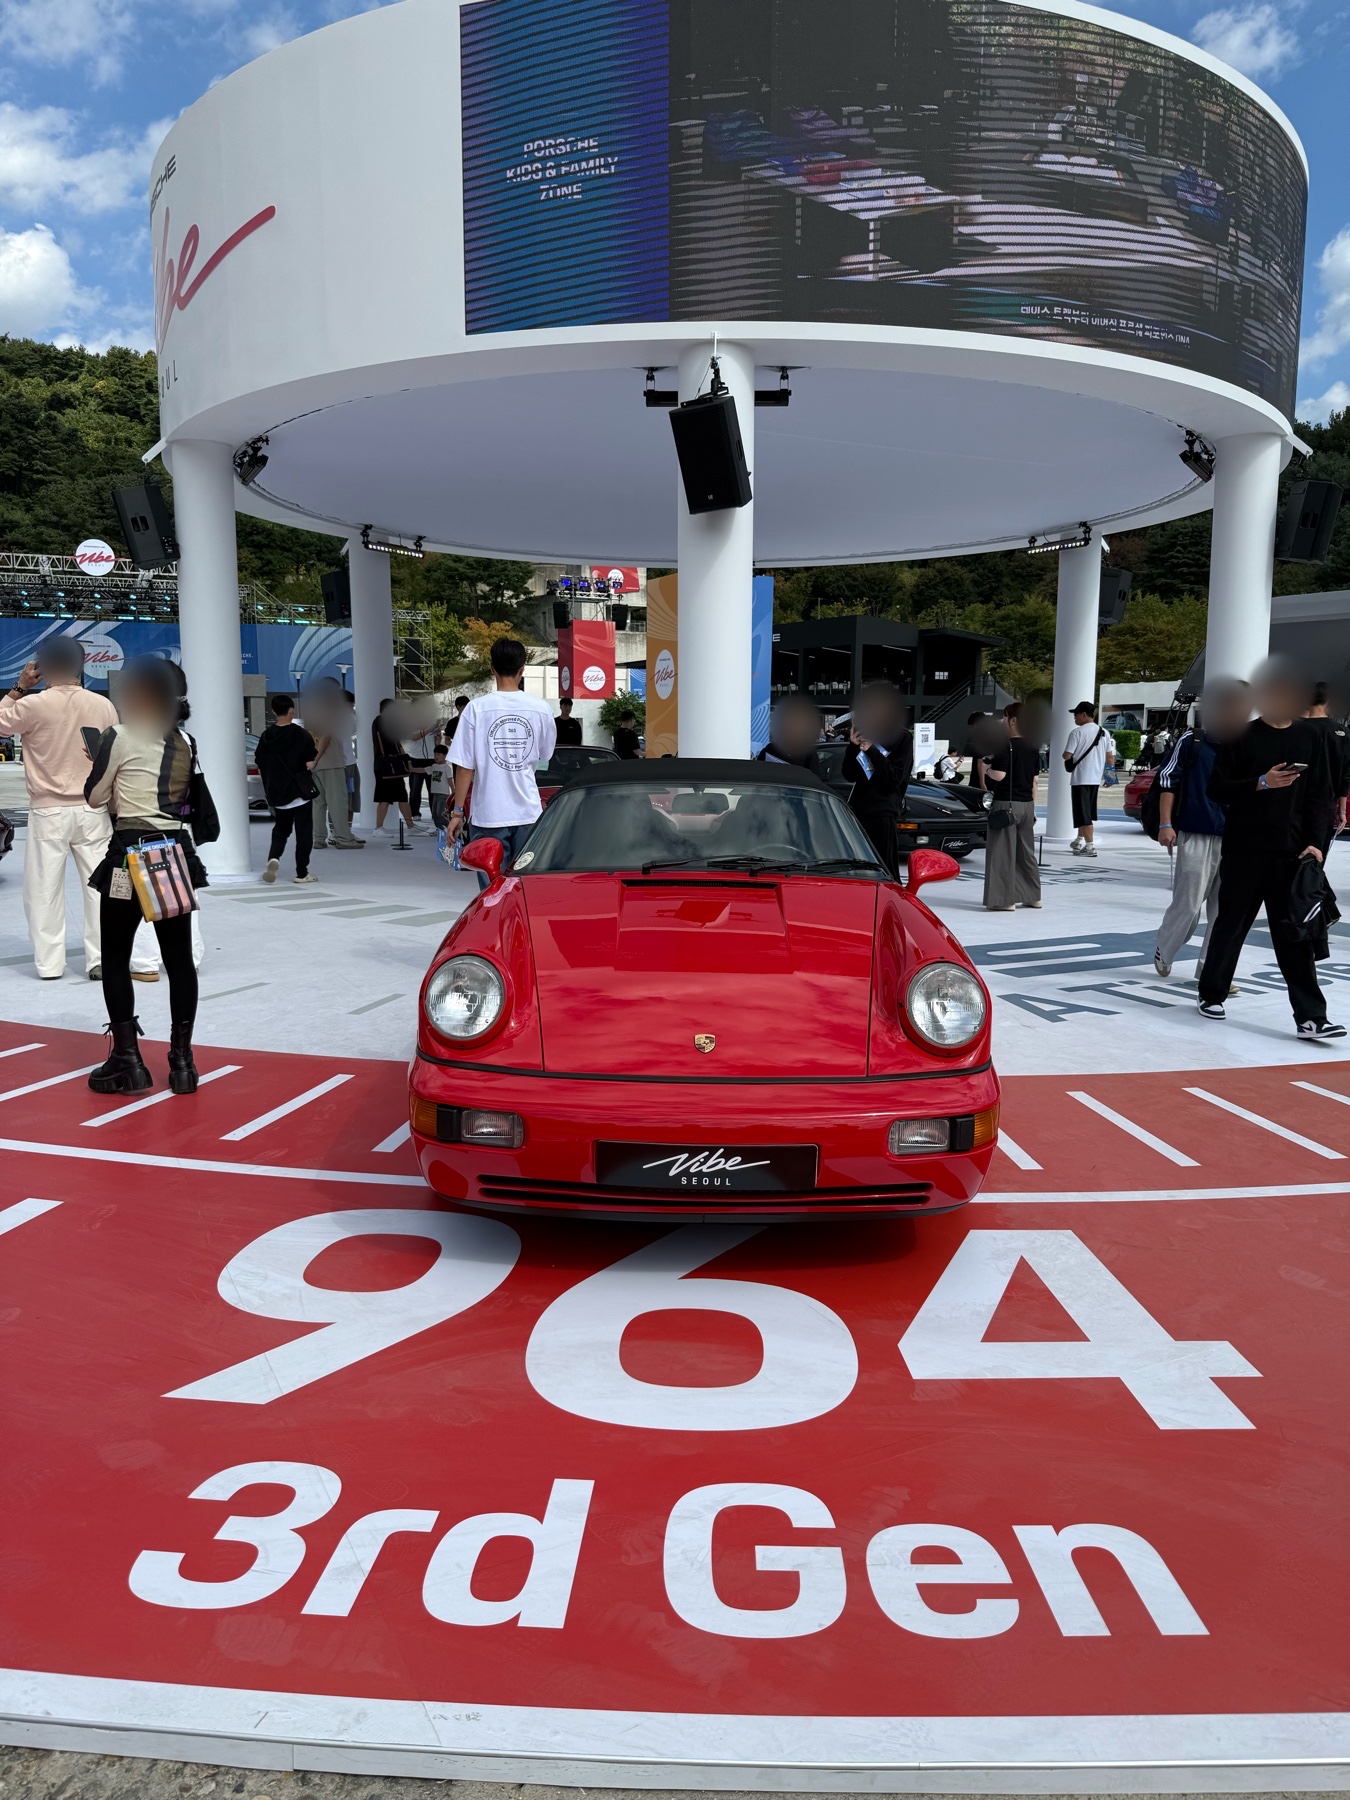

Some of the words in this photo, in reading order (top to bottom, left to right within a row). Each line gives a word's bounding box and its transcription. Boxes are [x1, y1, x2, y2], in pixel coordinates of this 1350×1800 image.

[523, 137, 599, 158] PORSCHE
[506, 162, 543, 182] KIDS
[545, 161, 557, 178] &
[560, 157, 619, 177] FAMILY
[539, 183, 582, 200] ZONE
[67, 551, 126, 565] Vibe
[82, 650, 130, 667] Vibe
[578, 673, 611, 683] Vibe
[650, 665, 678, 684] Vibe
[996, 992, 1123, 1023] A
[642, 1148, 771, 1176] Vibe
[681, 1177, 731, 1185] SEOUL
[163, 1209, 1263, 1431] 964
[129, 1461, 594, 1628] 3rd
[663, 1483, 1210, 1639] Gen
